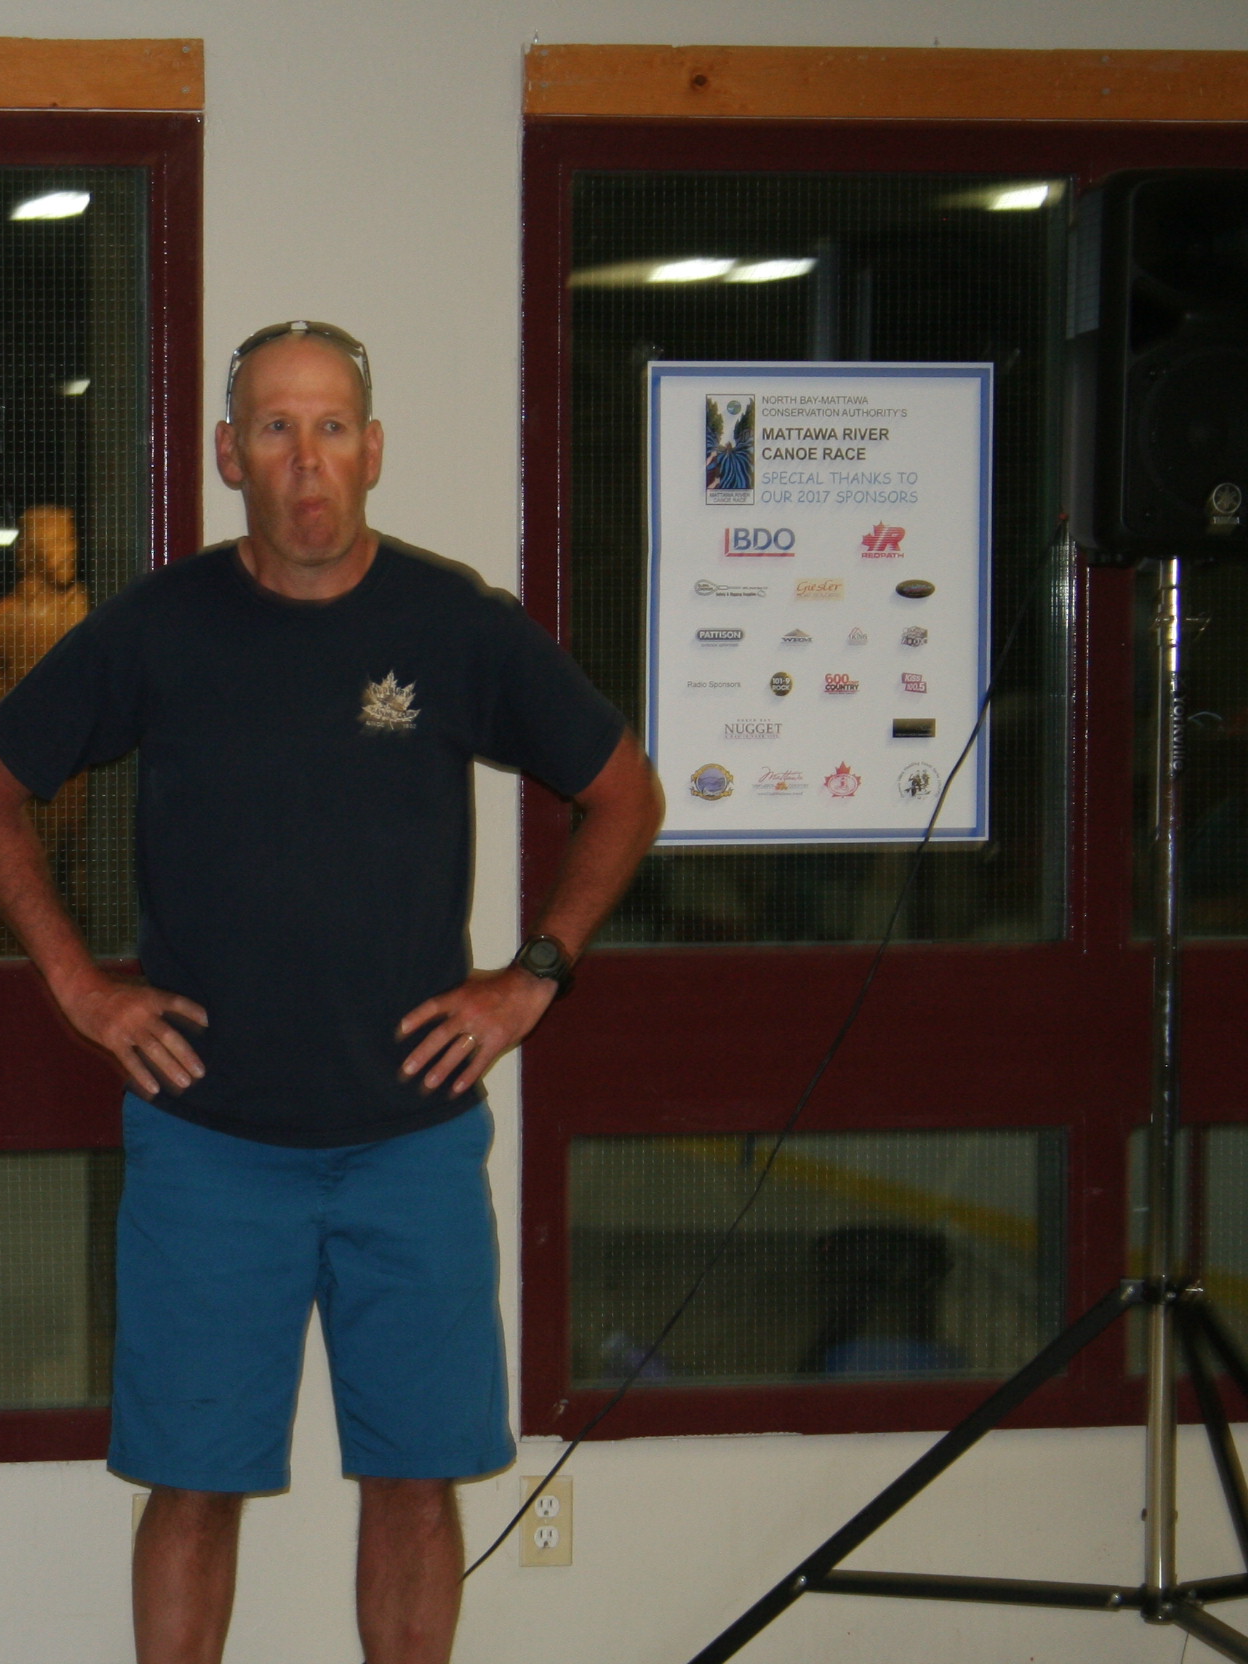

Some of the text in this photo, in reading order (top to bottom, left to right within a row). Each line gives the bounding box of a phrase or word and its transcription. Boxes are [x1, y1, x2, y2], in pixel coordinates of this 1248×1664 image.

[761, 395, 869, 405] NORTH BAY-MATTAWA
[761, 408, 908, 418] CONSERVATION AUTHORITY'S
[761, 427, 890, 441] MATTAWA RIVER
[761, 447, 867, 461] CANOE RACE
[761, 471, 918, 485] SPECIAL THANKS TO
[761, 490, 918, 504] OUR 2017 SPONSORS
[733, 527, 796, 551] BDO
[699, 631, 741, 640] PATTISON
[687, 680, 741, 690] Radio Sponsors
[825, 673, 849, 684] 600
[825, 683, 859, 691] COUNTRY
[724, 722, 783, 735] NUGGET
[1173, 697, 1185, 770] Yorkville
